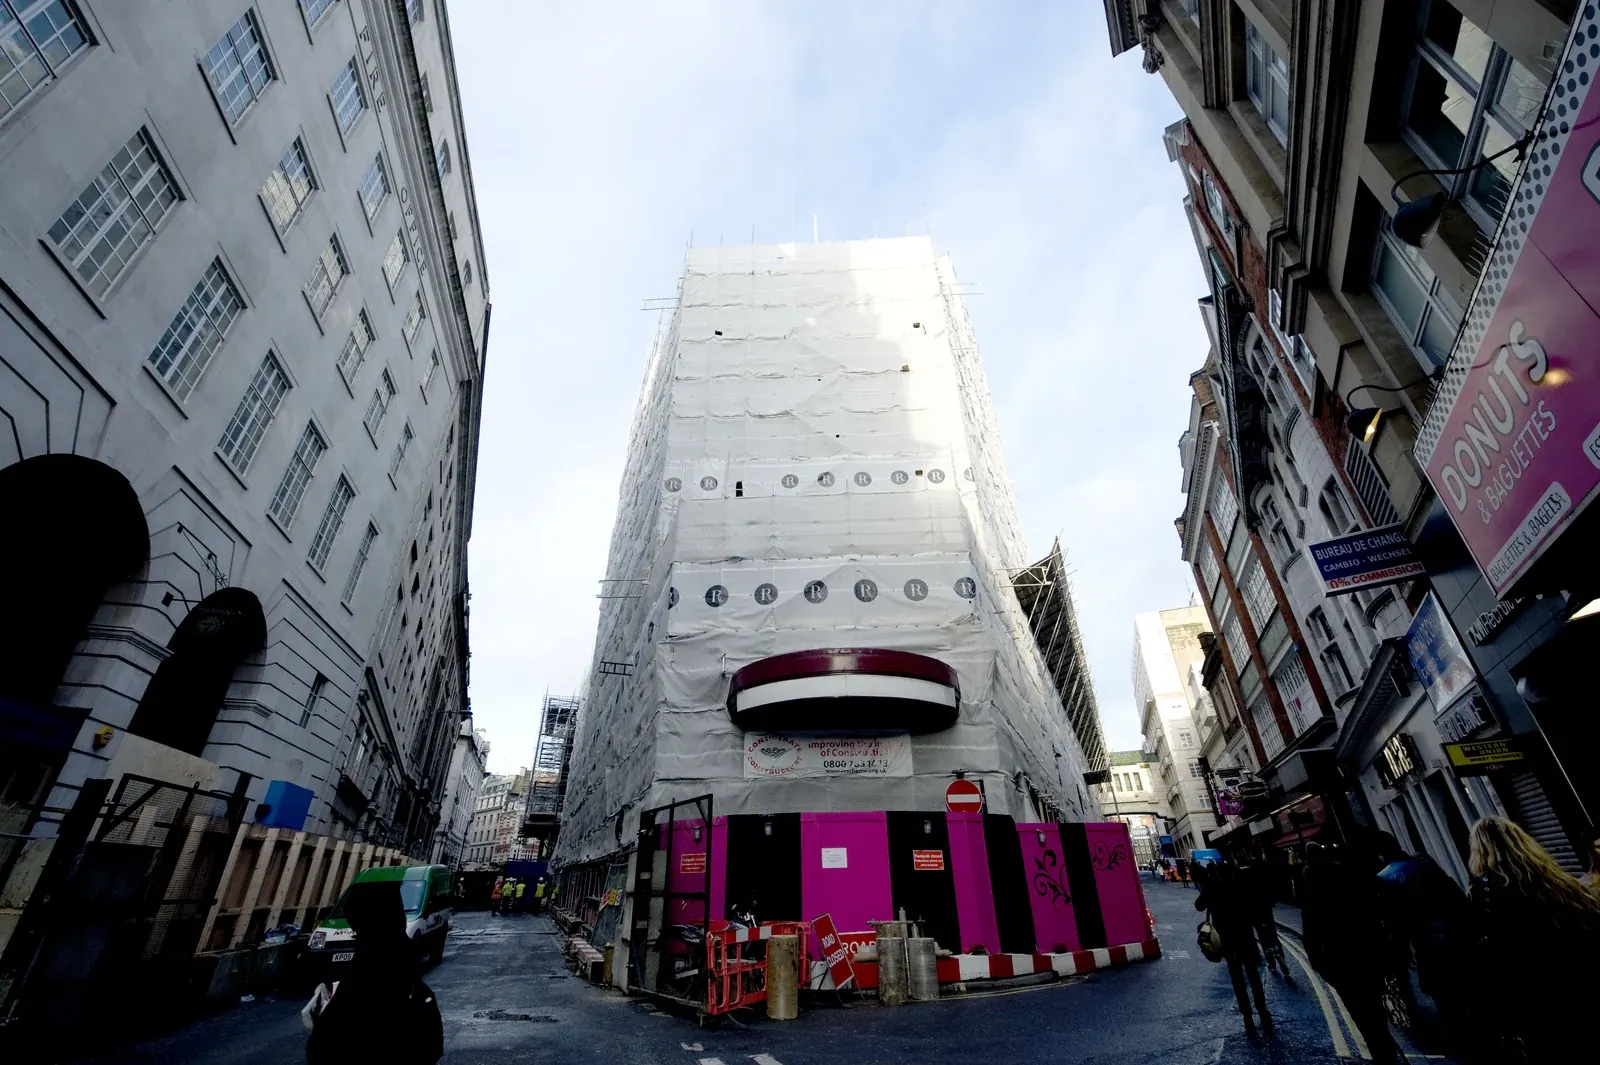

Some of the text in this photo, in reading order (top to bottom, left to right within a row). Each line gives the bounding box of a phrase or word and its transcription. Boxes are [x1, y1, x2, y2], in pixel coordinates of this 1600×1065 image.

[359, 25, 427, 278] FIRE OFFICE
[1440, 318, 1548, 512] DONUTS
[1477, 399, 1556, 524] & BAGUETTES
[1315, 532, 1407, 560] BUREAU DE CHANGE
[1323, 559, 1360, 572] CAMBIO
[1367, 548, 1413, 563] WECHSEL
[1490, 537, 1526, 582] BAGUETTES
[1330, 564, 1423, 589] 0% COMMISSION
[808, 740, 855, 750] improving
[1463, 742, 1507, 752] WESTERN
[823, 760, 847, 769] 0800
[821, 933, 836, 949] ROAD
[826, 948, 845, 968] CLOSED
